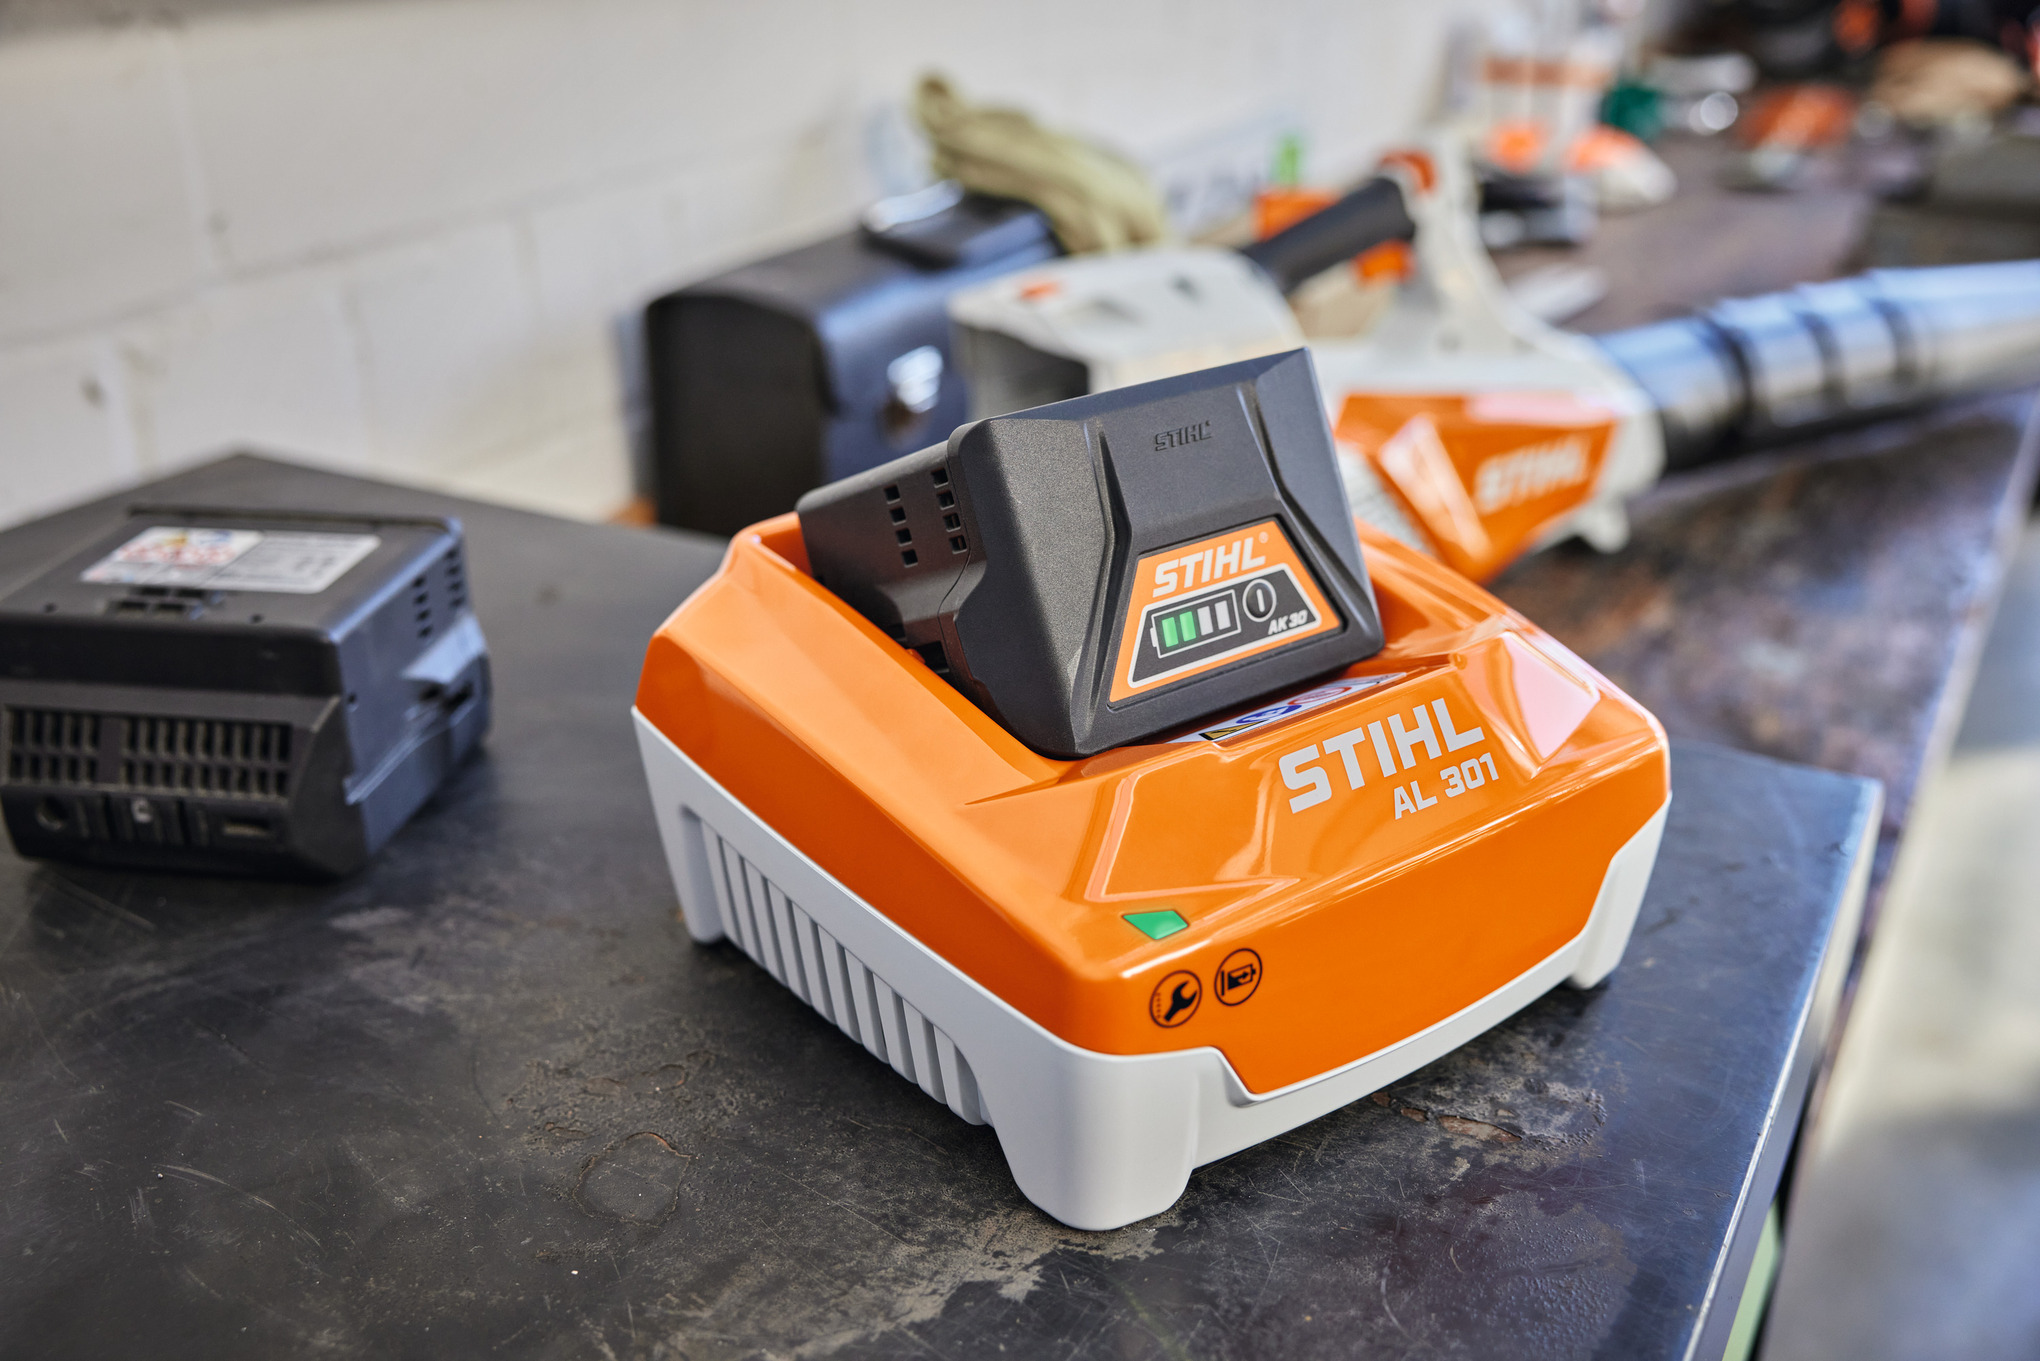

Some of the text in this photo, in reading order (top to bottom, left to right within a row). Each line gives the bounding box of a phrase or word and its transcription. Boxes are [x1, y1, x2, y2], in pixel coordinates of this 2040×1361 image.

[1155, 422, 1211, 451] STIHL
[1152, 537, 1266, 598] STIHL
[1268, 609, 1308, 635] AK 30
[1278, 698, 1485, 814] STIHL
[1393, 752, 1499, 820] AL 301
